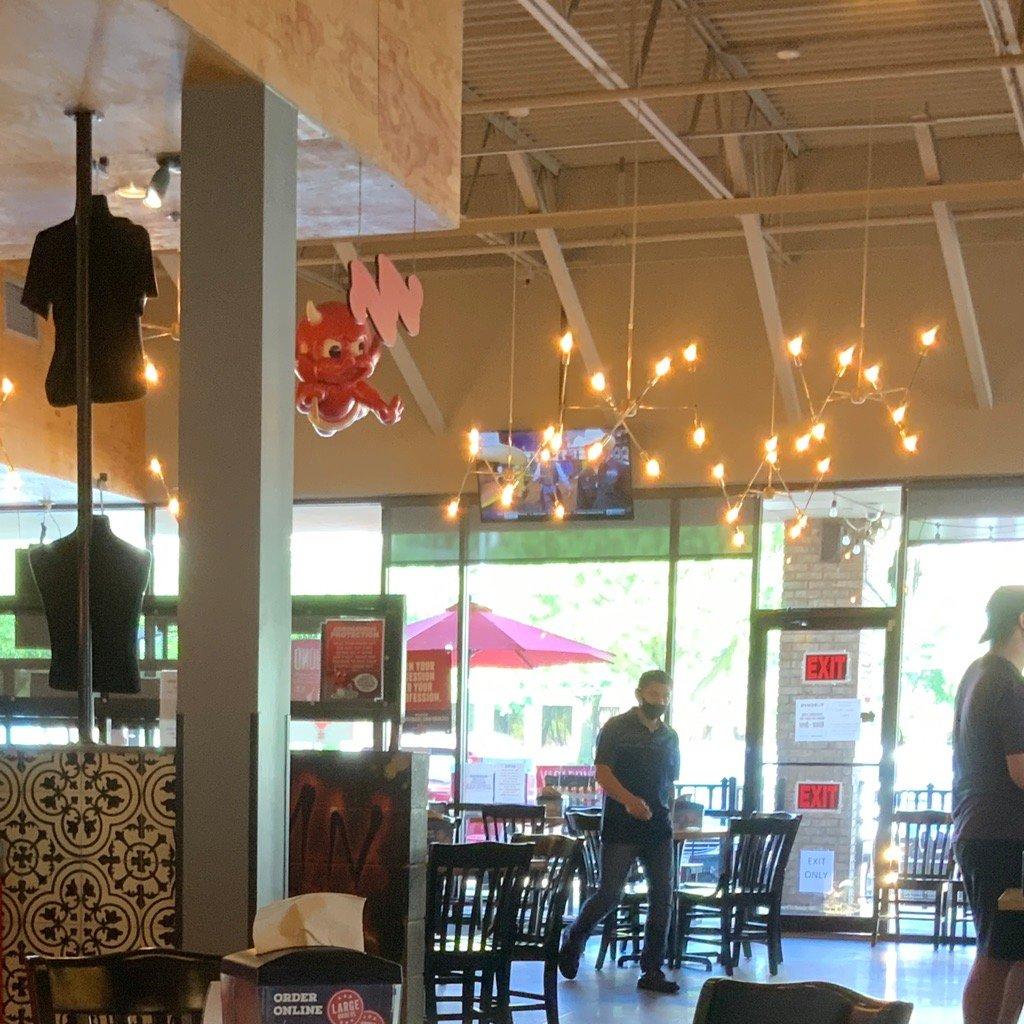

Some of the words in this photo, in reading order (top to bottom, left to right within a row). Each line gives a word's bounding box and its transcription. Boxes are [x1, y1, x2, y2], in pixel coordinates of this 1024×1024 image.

[807, 655, 845, 680] EXIT
[799, 785, 837, 808] EXIT
[808, 857, 825, 866] EXIT
[804, 871, 829, 879] ONLY
[273, 992, 317, 1003] ORDER
[273, 1005, 323, 1015] ONLINE
[332, 999, 359, 1015] LARGE
